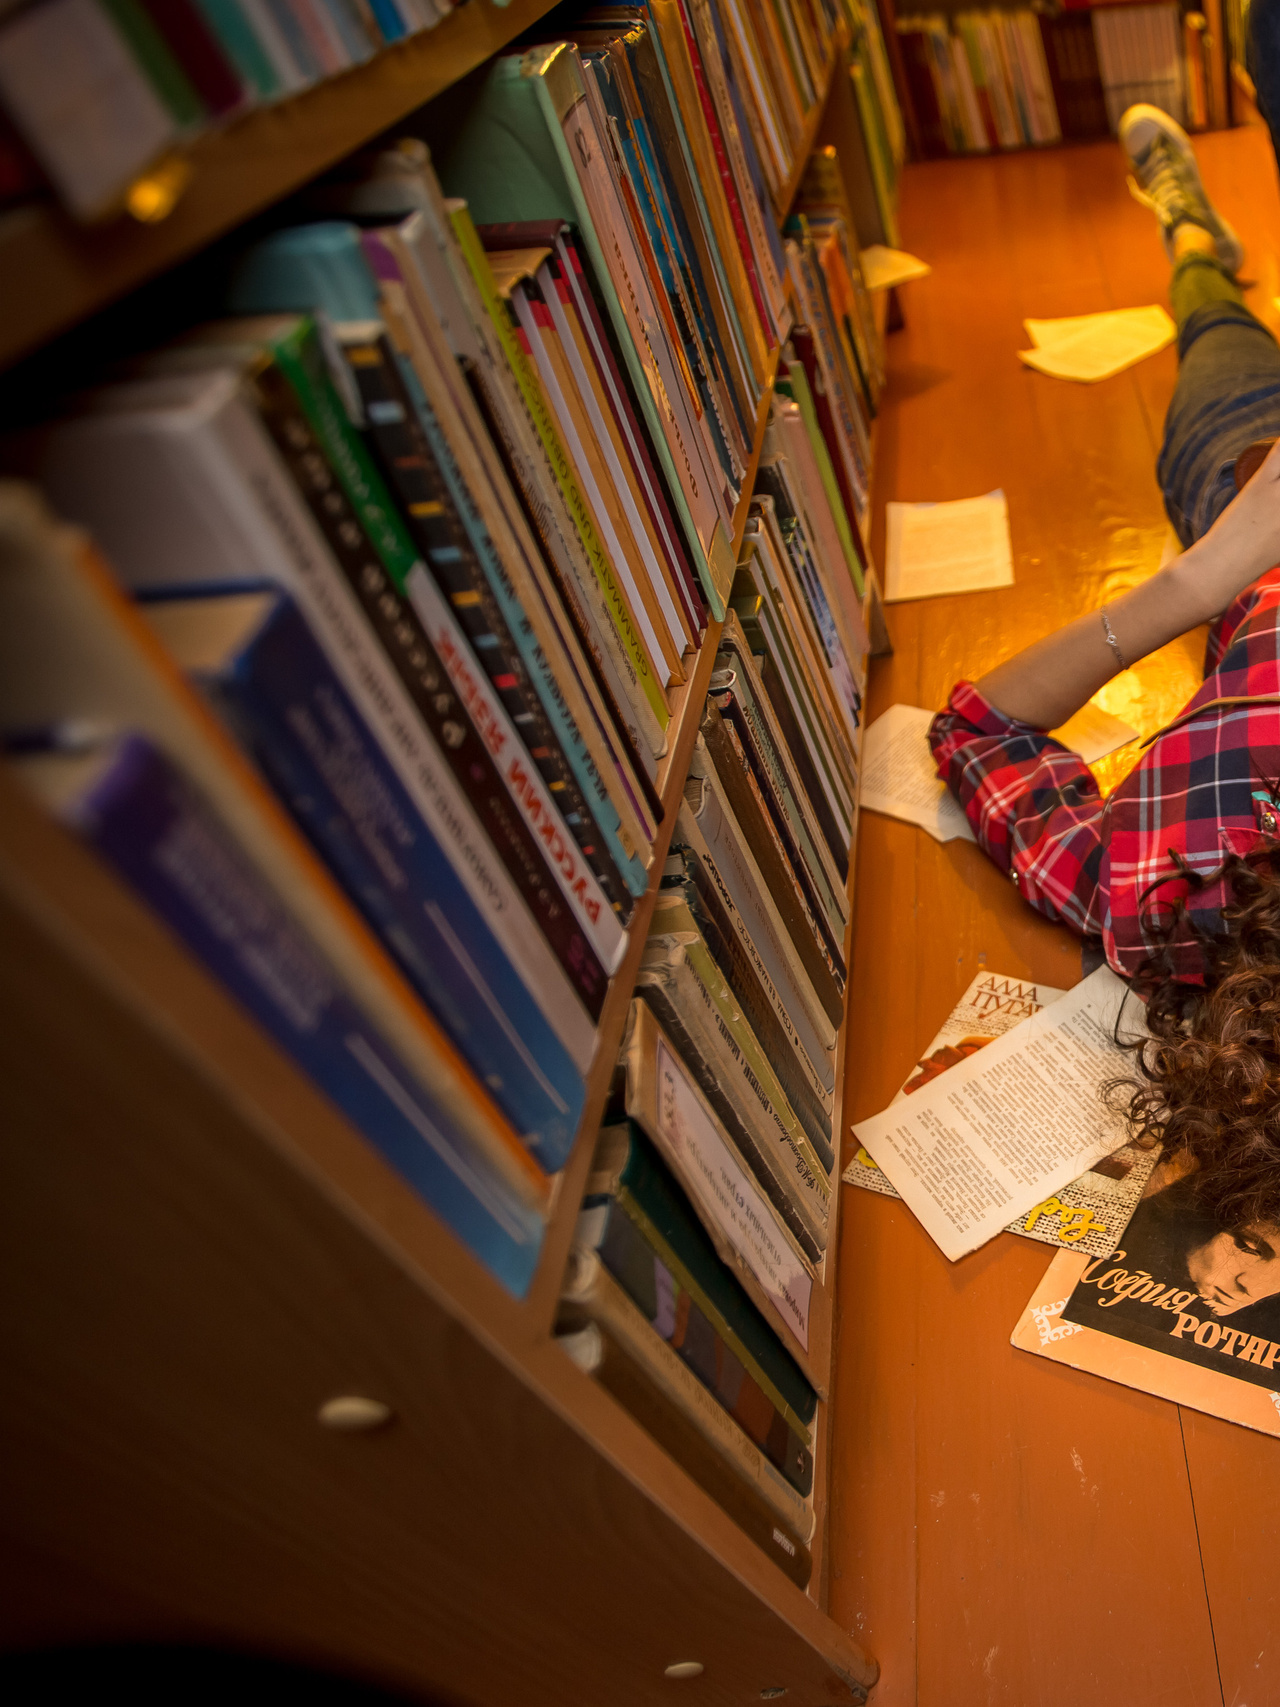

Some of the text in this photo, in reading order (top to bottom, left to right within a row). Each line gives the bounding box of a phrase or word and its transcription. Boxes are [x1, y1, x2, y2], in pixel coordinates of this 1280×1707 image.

[567, 484, 596, 539] UND
[588, 538, 650, 677] GRAMMATIK
[977, 976, 1038, 1001] АЛЛА
[1079, 1250, 1198, 1316] София
